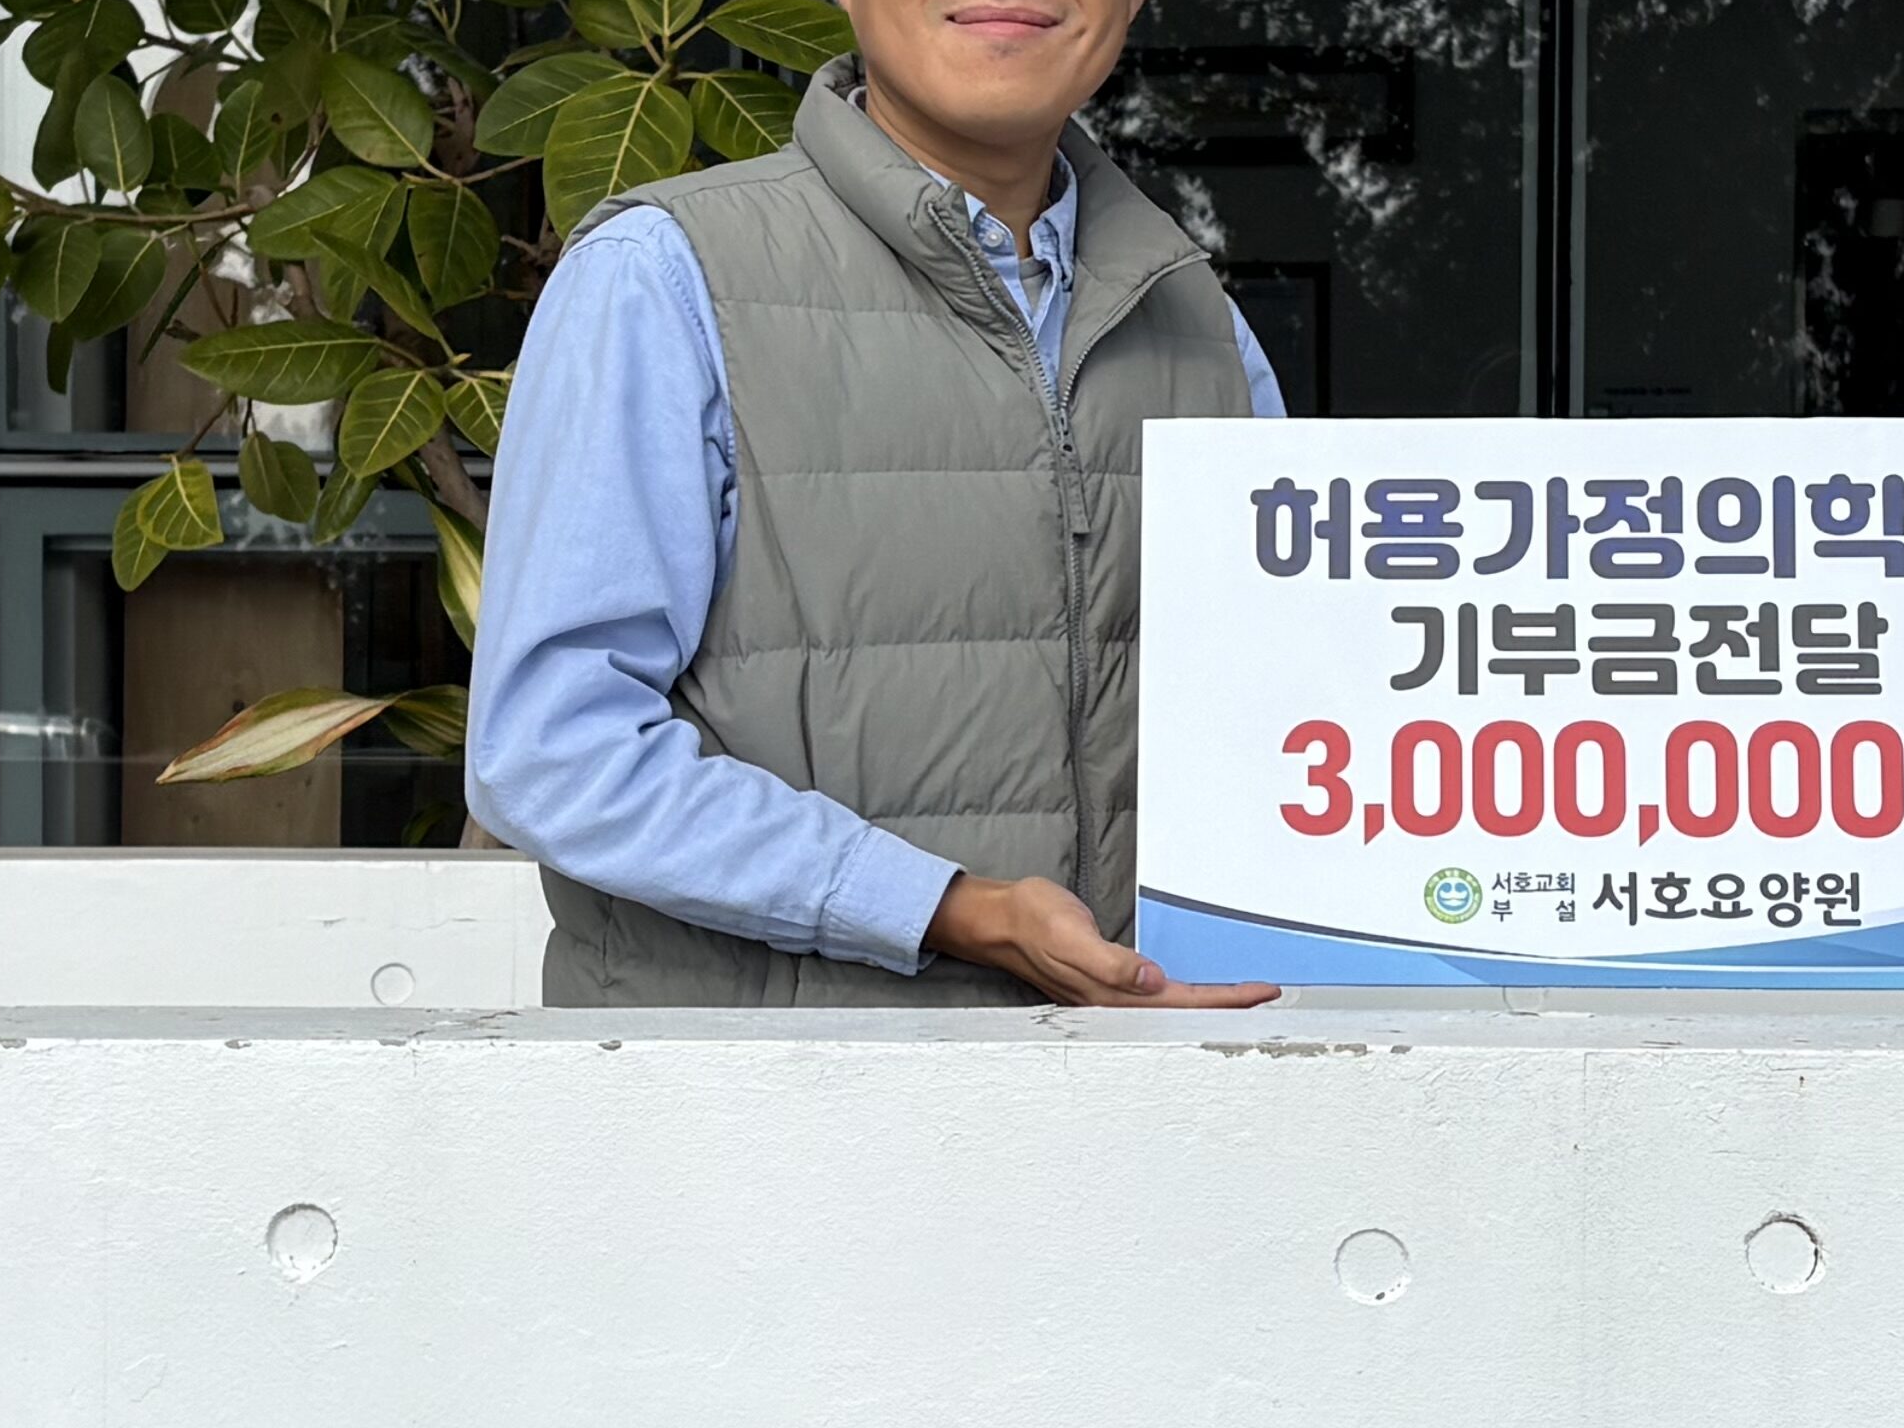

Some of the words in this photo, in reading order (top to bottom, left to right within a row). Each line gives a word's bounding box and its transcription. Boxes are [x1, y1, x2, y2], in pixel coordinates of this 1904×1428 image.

[1389, 601, 1888, 697] 기부금전달
[1491, 871, 1576, 895] 서호교회
[1592, 871, 1862, 929] 서호요양원
